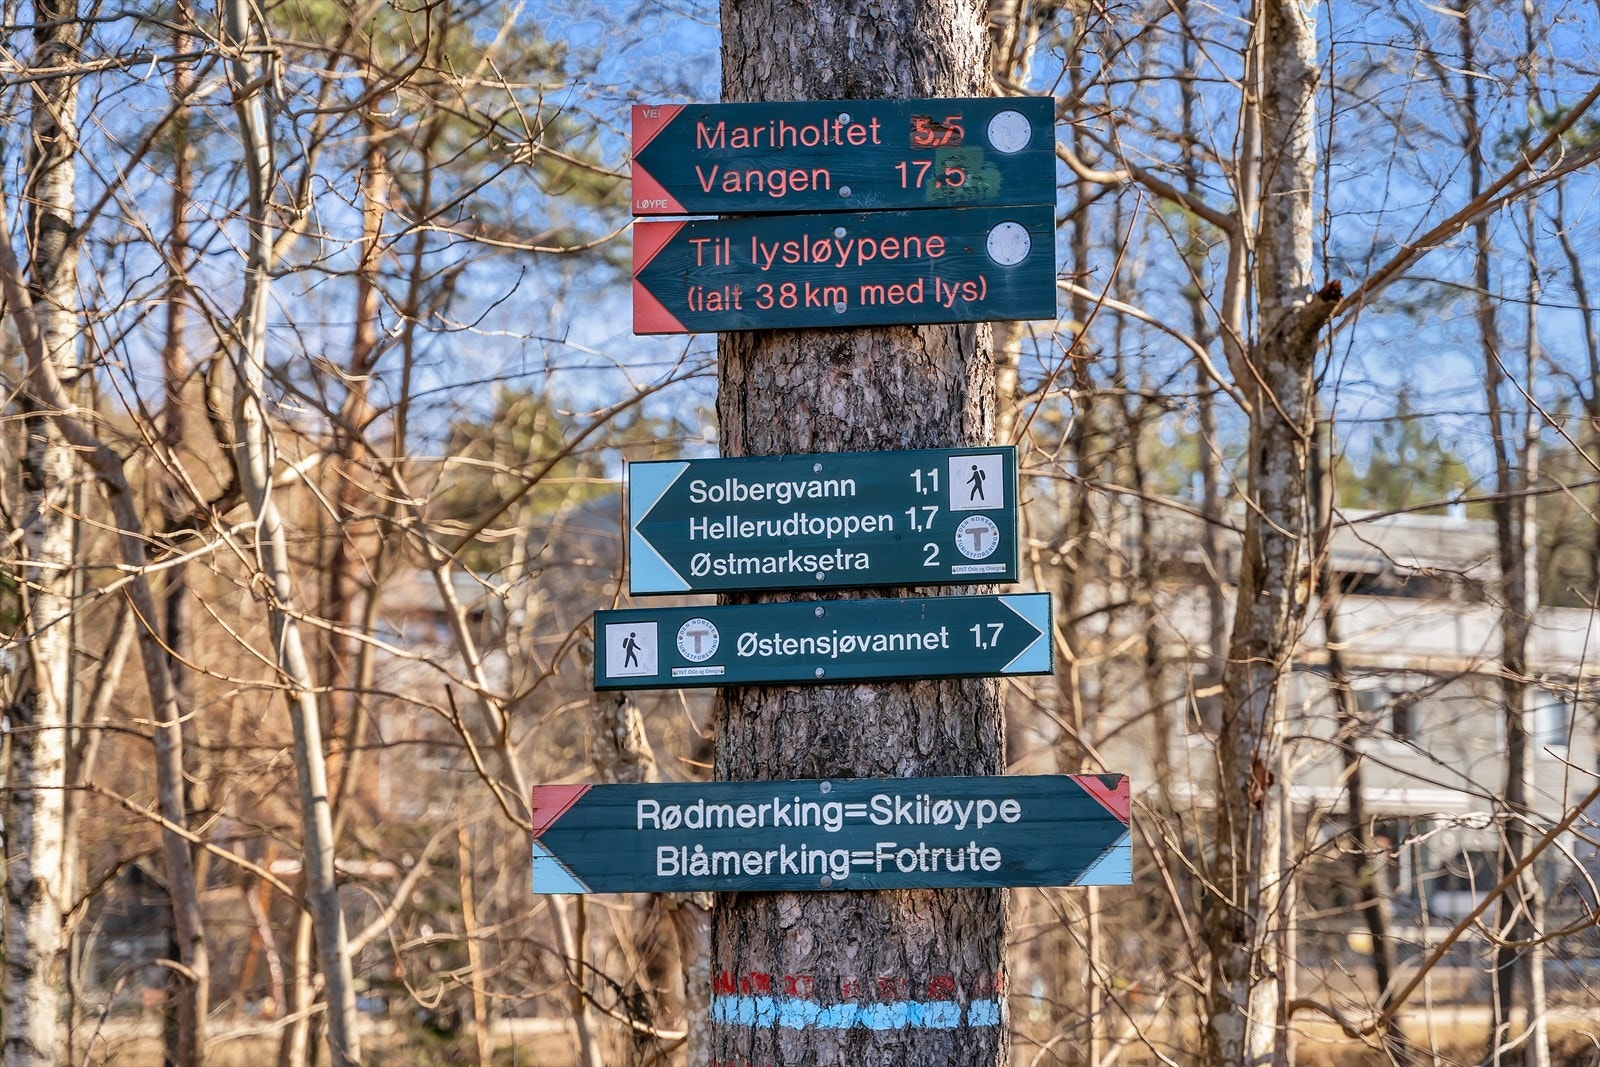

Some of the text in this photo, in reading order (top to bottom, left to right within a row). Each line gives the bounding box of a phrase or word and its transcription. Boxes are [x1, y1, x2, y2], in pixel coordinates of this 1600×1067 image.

[696, 116, 881, 149] Mariholtet
[696, 162, 831, 197] Vangen
[636, 199, 668, 209] LØYPE
[689, 235, 946, 270] Til lysløypene
[687, 285, 743, 312] (ialt
[860, 277, 925, 304] med
[934, 275, 988, 308] lys)
[689, 467, 940, 505] Solbergvann 1,1
[689, 506, 939, 542] Hellerudtoppen 1,7
[971, 516, 995, 530] NORSKE
[690, 543, 940, 576] Østmarksetra 2
[958, 537, 998, 558] TURISTFORENING
[692, 620, 716, 633] NORSKE
[736, 623, 1005, 658] Østensjøvannet 1,7
[679, 640, 718, 660] TURISTFORENING
[636, 795, 1022, 832] Rødmerking=Skiløype
[656, 841, 1002, 880] Blåmerking=Fotrute
